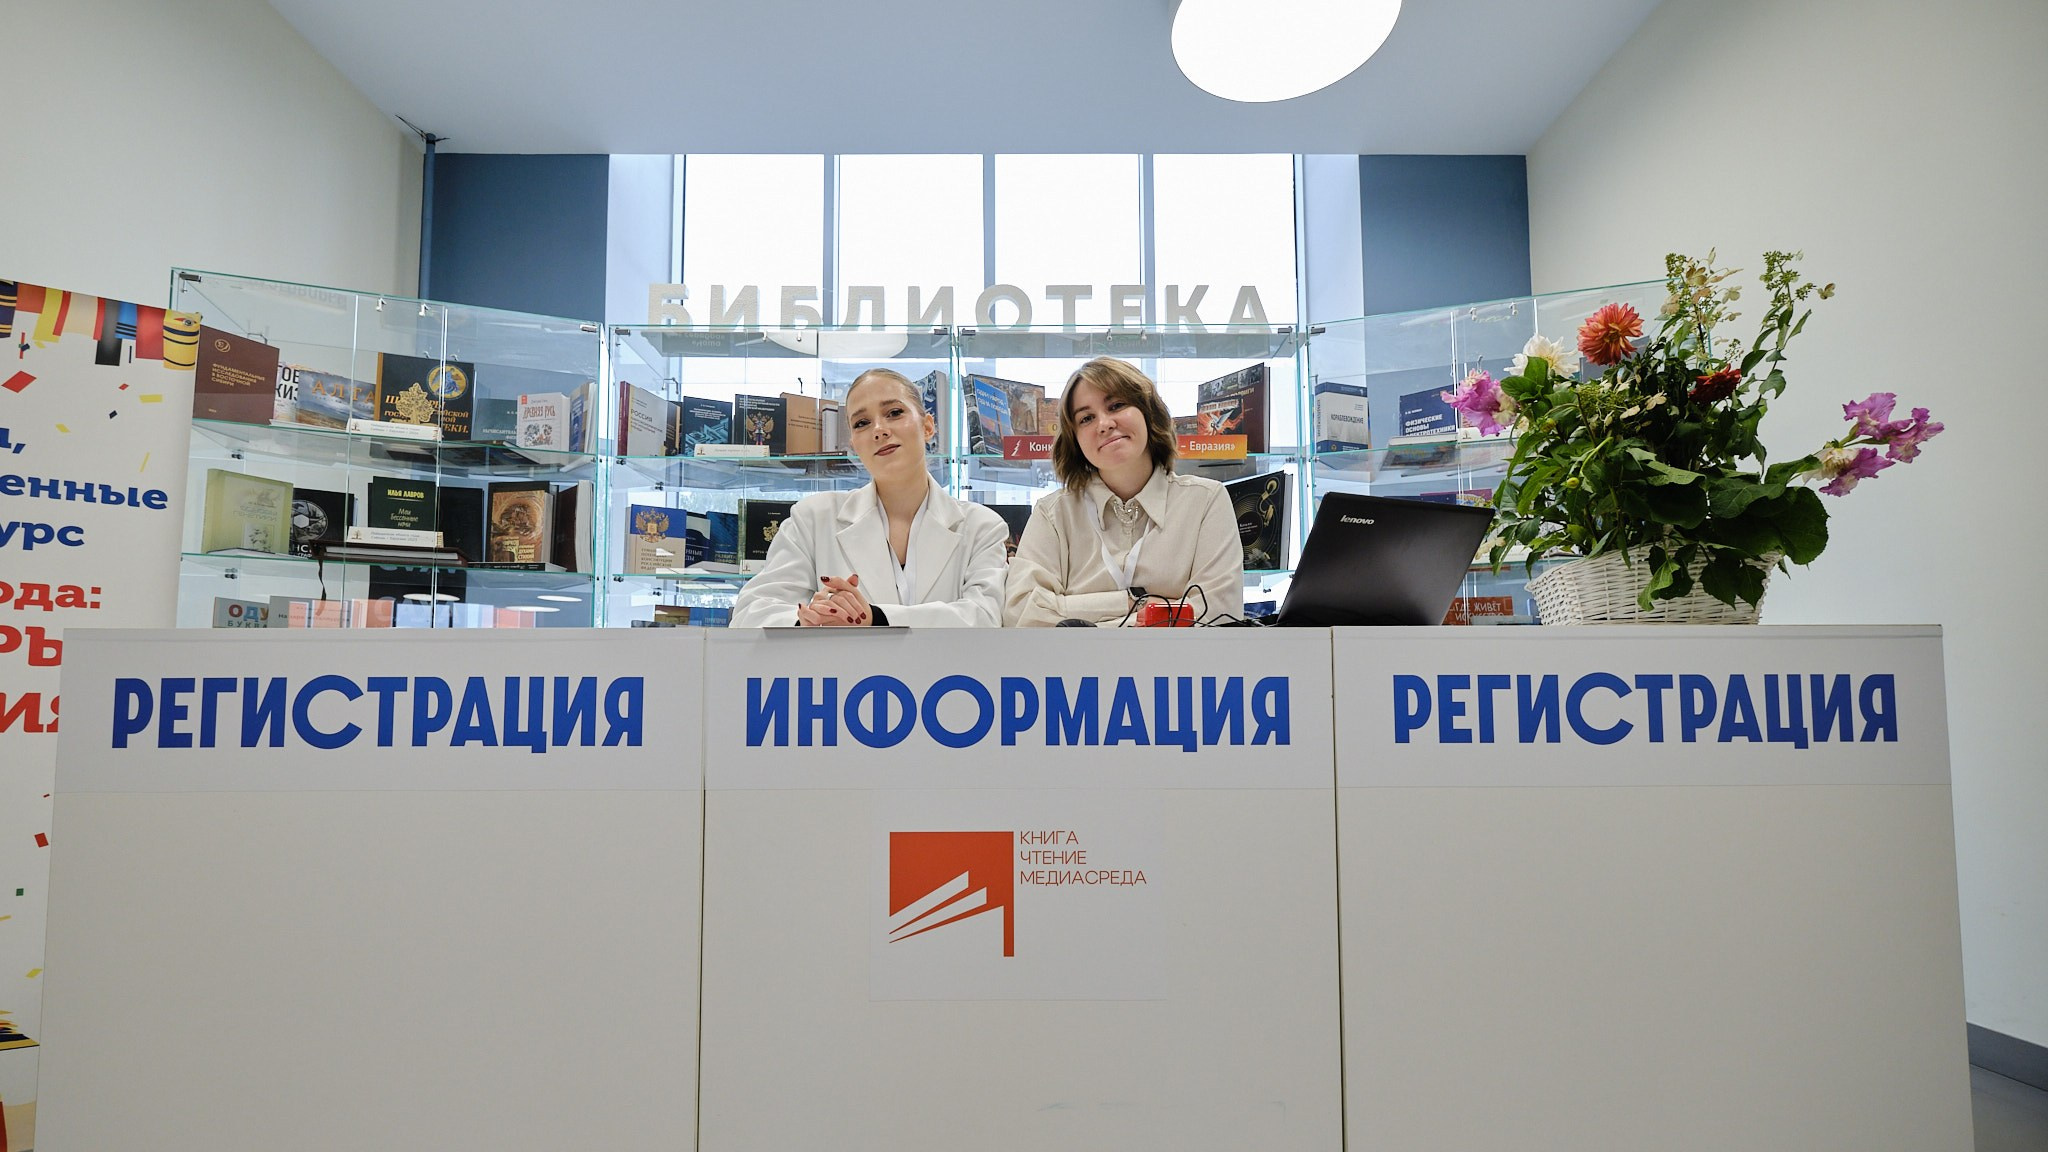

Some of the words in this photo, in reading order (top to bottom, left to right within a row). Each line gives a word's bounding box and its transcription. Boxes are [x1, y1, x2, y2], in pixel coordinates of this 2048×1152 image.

[648, 284, 1272, 331] БИБЛИОТЕКА
[1405, 413, 1443, 427] ФИЗИЧЕСКИЕ
[1405, 423, 1430, 433] ОСНОВЫ
[1189, 441, 1236, 453] Евразия»
[387, 489, 402, 497] ИЛЬЯ
[403, 490, 425, 499] ЛАВРОВ
[1340, 514, 1375, 525] lenovo
[1473, 601, 1502, 612] ЖИВЁТ
[112, 674, 645, 754] РЕГИСТРАЦИЯ
[746, 674, 1291, 753] ИНФОРМАЦИЯ
[1393, 672, 1898, 750] РЕГИСТРАЦИЯ
[1020, 830, 1079, 845] КНИГА
[1020, 850, 1087, 865] ЧТЕНИЕ
[1020, 870, 1147, 886] МЕДИАСРЕДА
